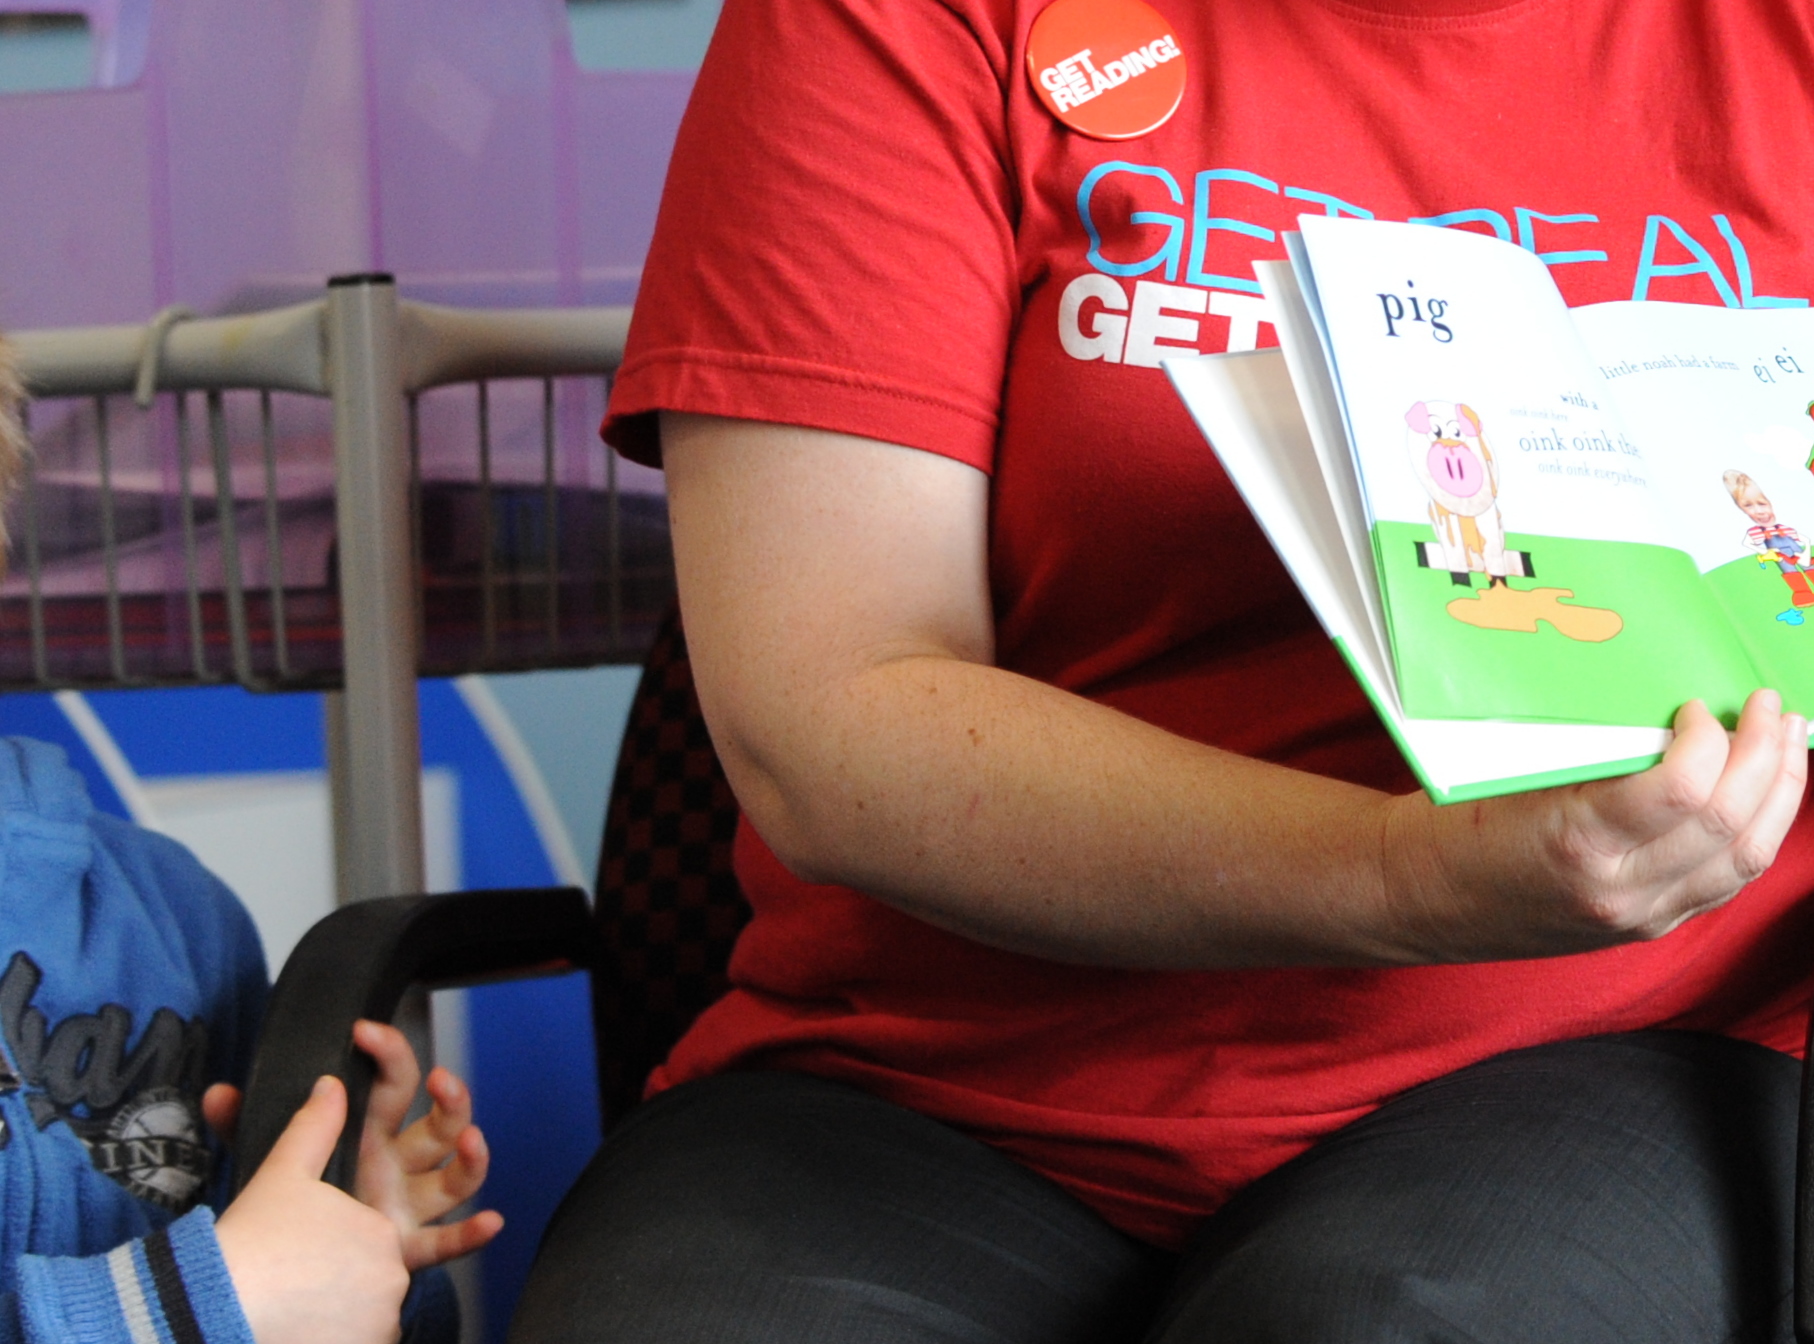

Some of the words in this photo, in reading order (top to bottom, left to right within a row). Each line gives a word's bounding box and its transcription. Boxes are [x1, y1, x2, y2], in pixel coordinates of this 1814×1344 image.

[1040, 48, 1096, 92] GET
[1050, 34, 1182, 113] READING!
[1058, 273, 1279, 370] GET
[1376, 279, 1453, 343] pig
[1599, 360, 1640, 380] little
[1642, 354, 1677, 372] noah
[1675, 354, 1703, 369] had
[1702, 359, 1711, 369] a
[1708, 354, 1741, 371] farm
[1753, 357, 1777, 384] ei
[1774, 346, 1805, 375] ei
[1560, 391, 1589, 408] with
[1592, 400, 1600, 411] a
[1519, 427, 1568, 452] oink
[1572, 429, 1616, 453] oink
[1538, 457, 1563, 475] oink
[1566, 461, 1591, 477] oink
